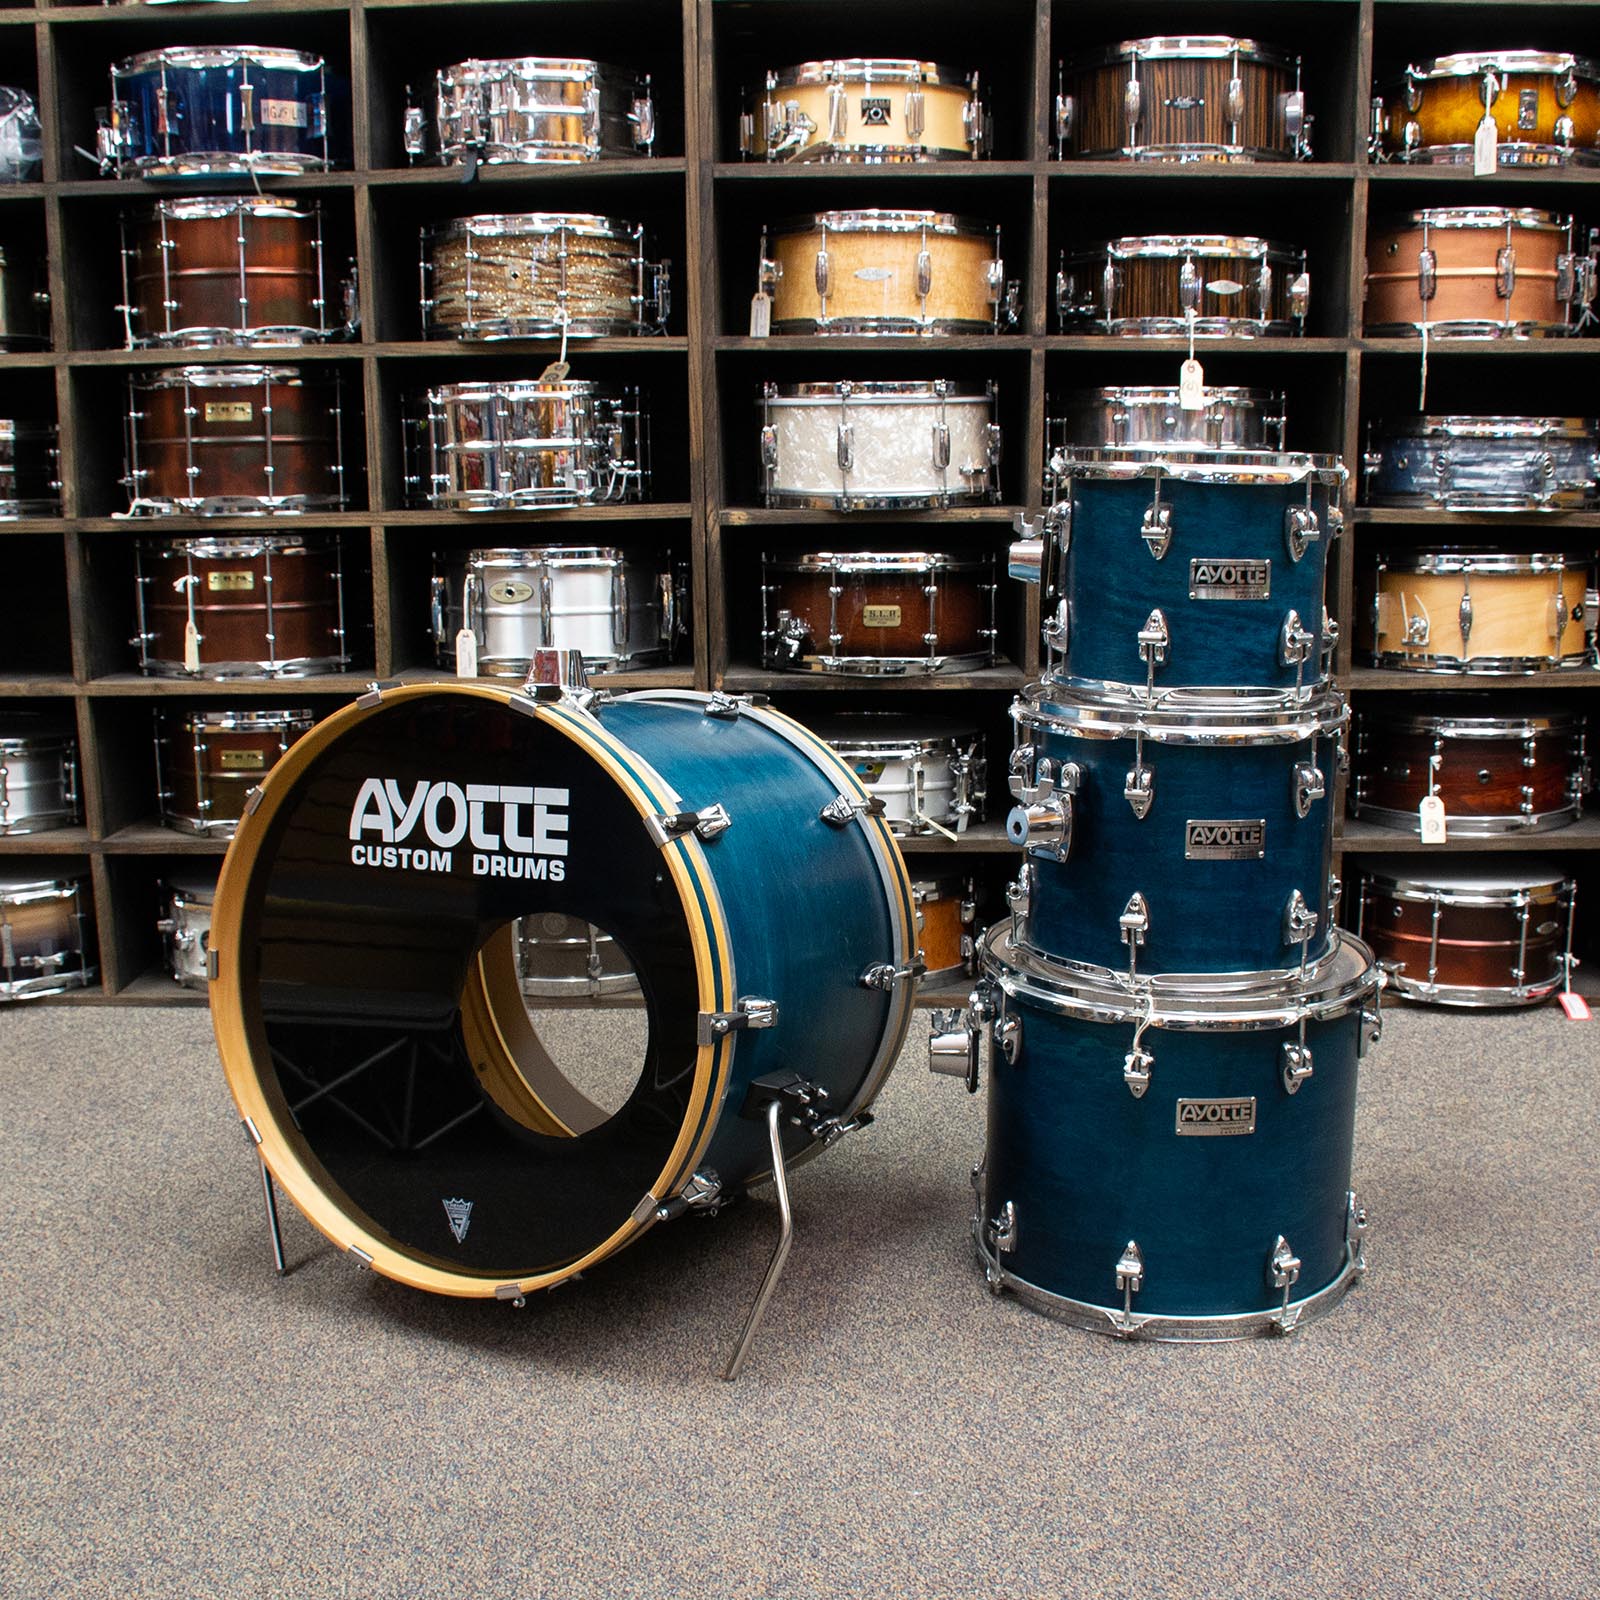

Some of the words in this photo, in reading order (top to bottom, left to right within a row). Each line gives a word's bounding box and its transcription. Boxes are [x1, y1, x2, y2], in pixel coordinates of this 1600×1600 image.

[1195, 565, 1266, 585] AYOTTE
[349, 777, 569, 856] AYOTTE
[1191, 826, 1260, 845] AYOTTE
[351, 844, 452, 873] CUSTOM
[472, 853, 565, 882] DRUMS
[1181, 1104, 1251, 1121] AYOTTE
